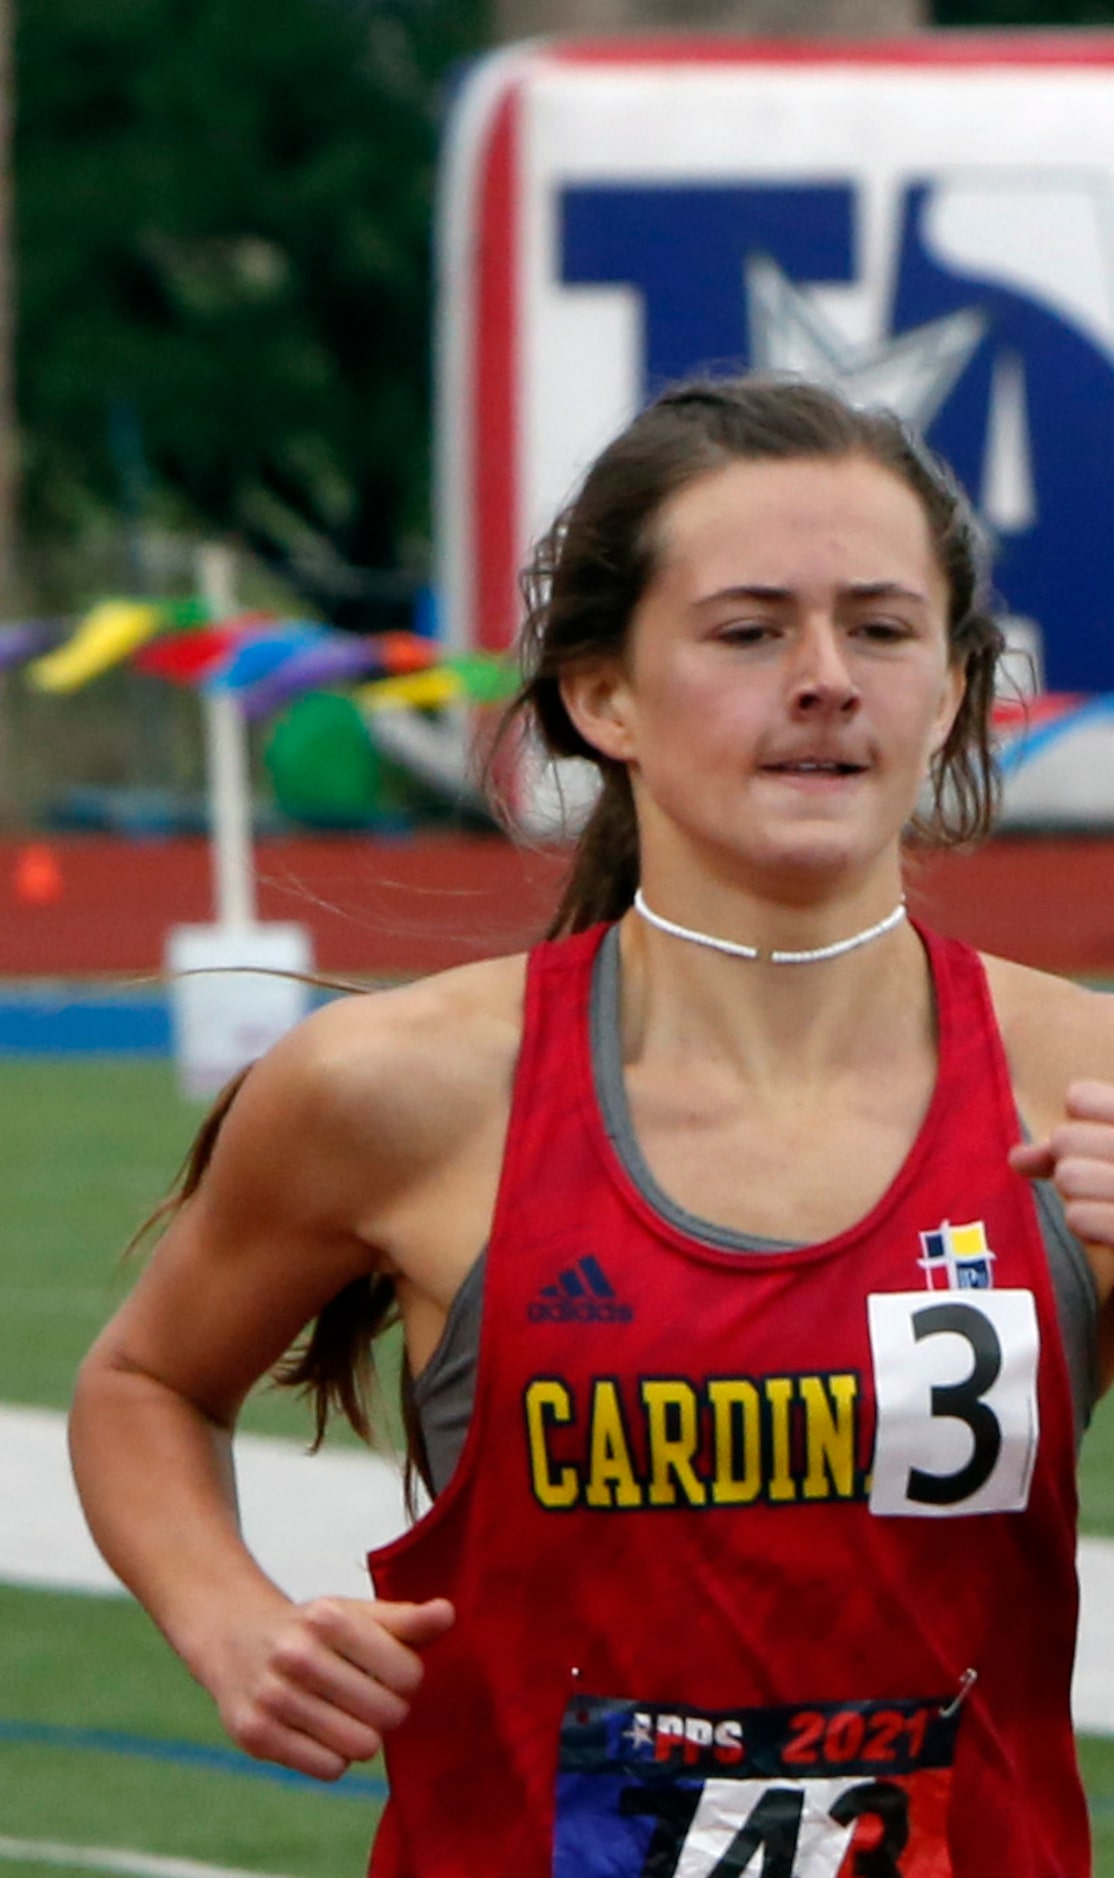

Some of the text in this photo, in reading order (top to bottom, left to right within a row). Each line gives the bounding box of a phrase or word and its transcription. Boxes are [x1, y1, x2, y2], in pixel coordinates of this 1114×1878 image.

[527, 1299, 634, 1323] adidas
[524, 1370, 875, 1512] CARDIN
[906, 1302, 1002, 1505] 3
[781, 1709, 928, 1764] 2021
